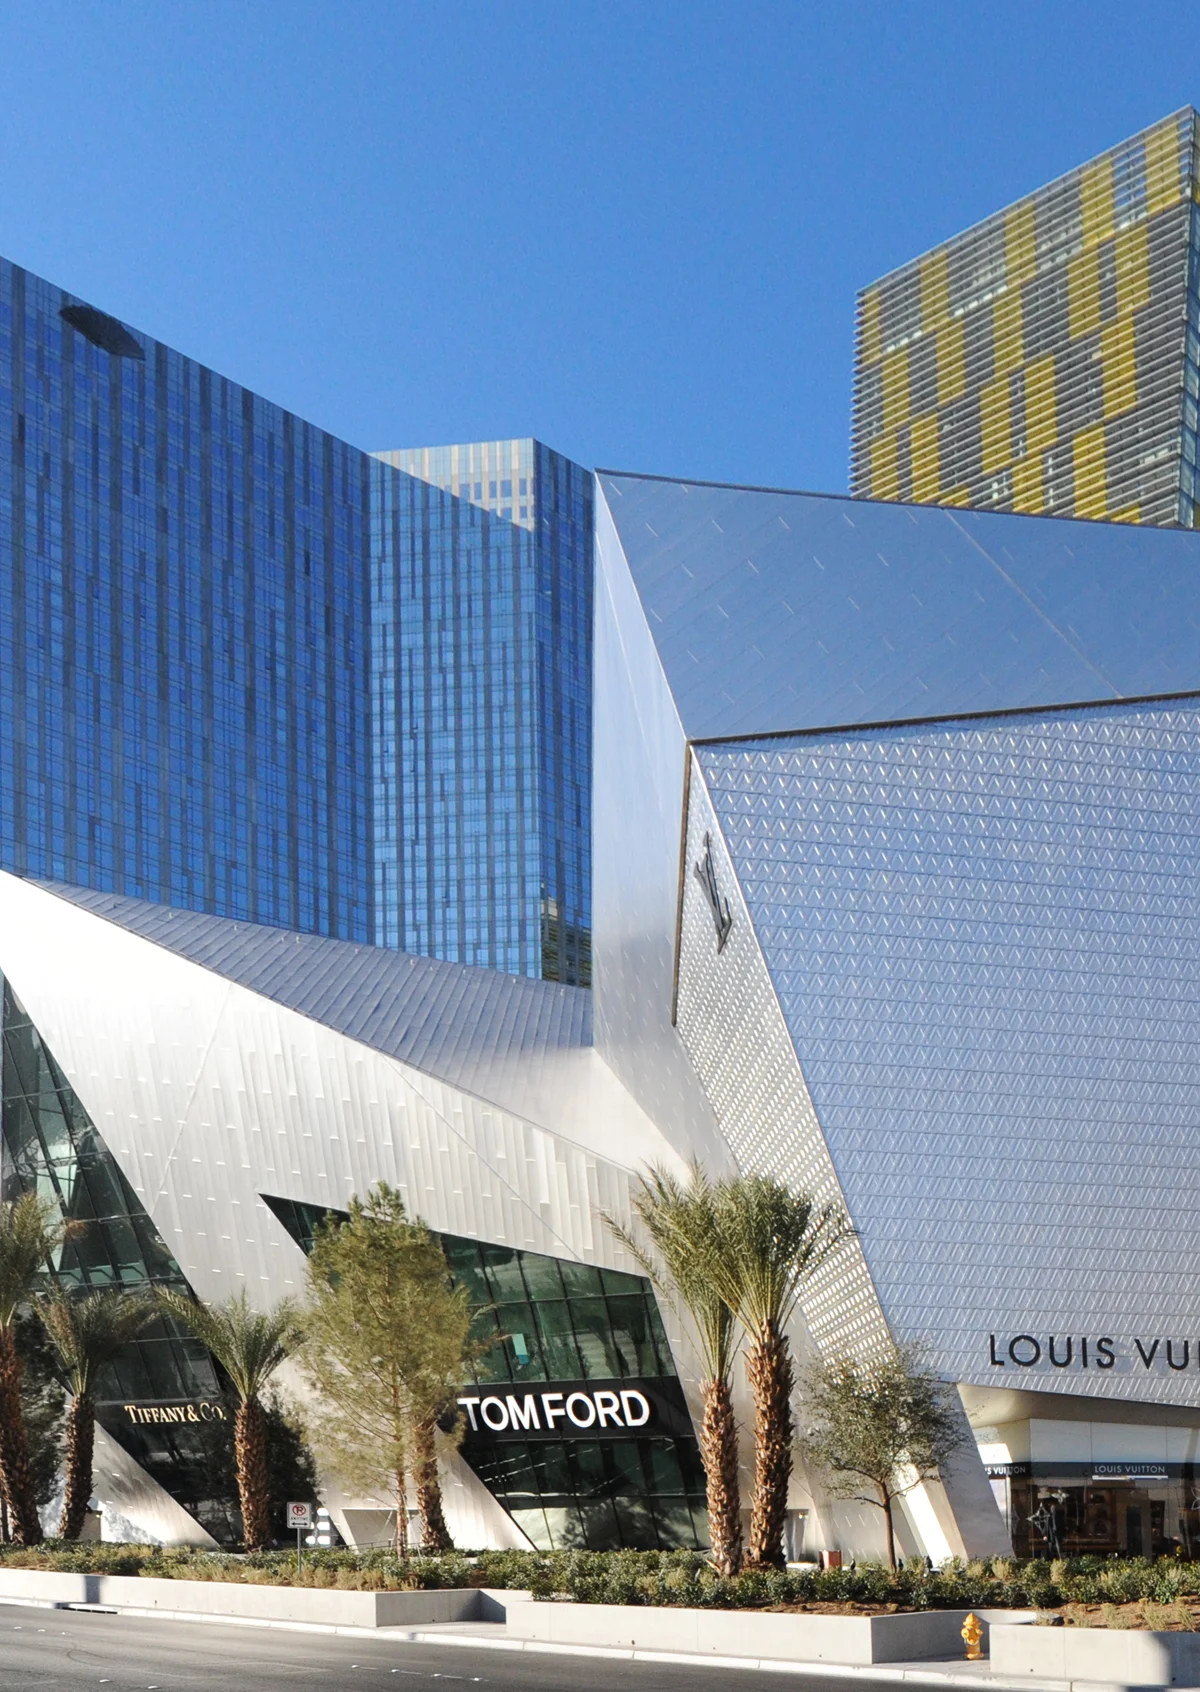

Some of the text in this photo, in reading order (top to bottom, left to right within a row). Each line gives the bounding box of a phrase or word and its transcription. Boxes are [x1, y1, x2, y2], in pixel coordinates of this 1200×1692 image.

[989, 1334, 1115, 1369] LOUIS
[457, 1389, 650, 1431] TOM FORD
[1094, 1465, 1165, 1473] LOUIS VUITTON
